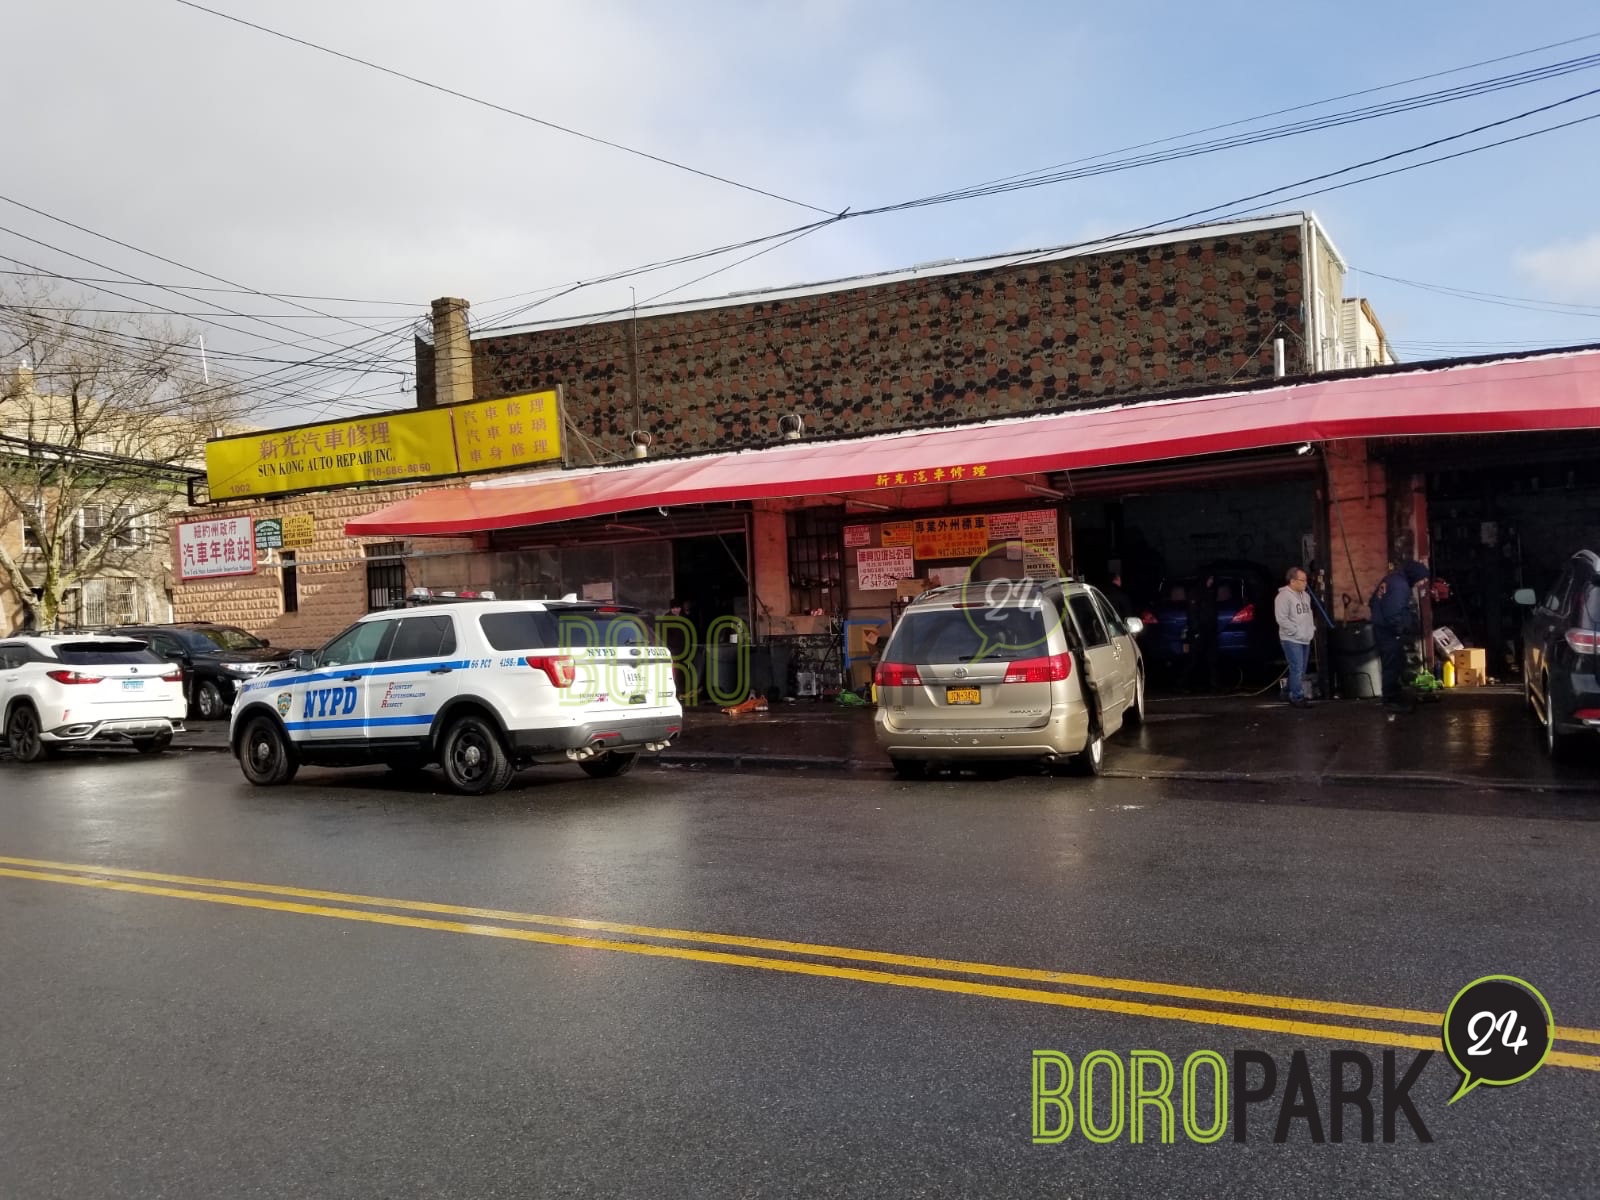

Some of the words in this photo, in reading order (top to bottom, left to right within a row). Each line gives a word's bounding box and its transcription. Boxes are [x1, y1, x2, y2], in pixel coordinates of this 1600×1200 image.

[463, 398, 545, 425] 汽車修理
[259, 421, 392, 460] 新光汽車修理
[470, 439, 549, 463] 車身修理
[258, 463, 276, 478] SUN
[279, 459, 304, 476] KONG
[308, 455, 333, 472] AUTO
[336, 449, 373, 468] REPAIR
[193, 520, 237, 539] 紐約州政府
[183, 536, 251, 567] 汽車年檢站
[470, 659, 479, 669] 66
[587, 648, 616, 657] NYPD
[303, 686, 358, 718] NYPD
